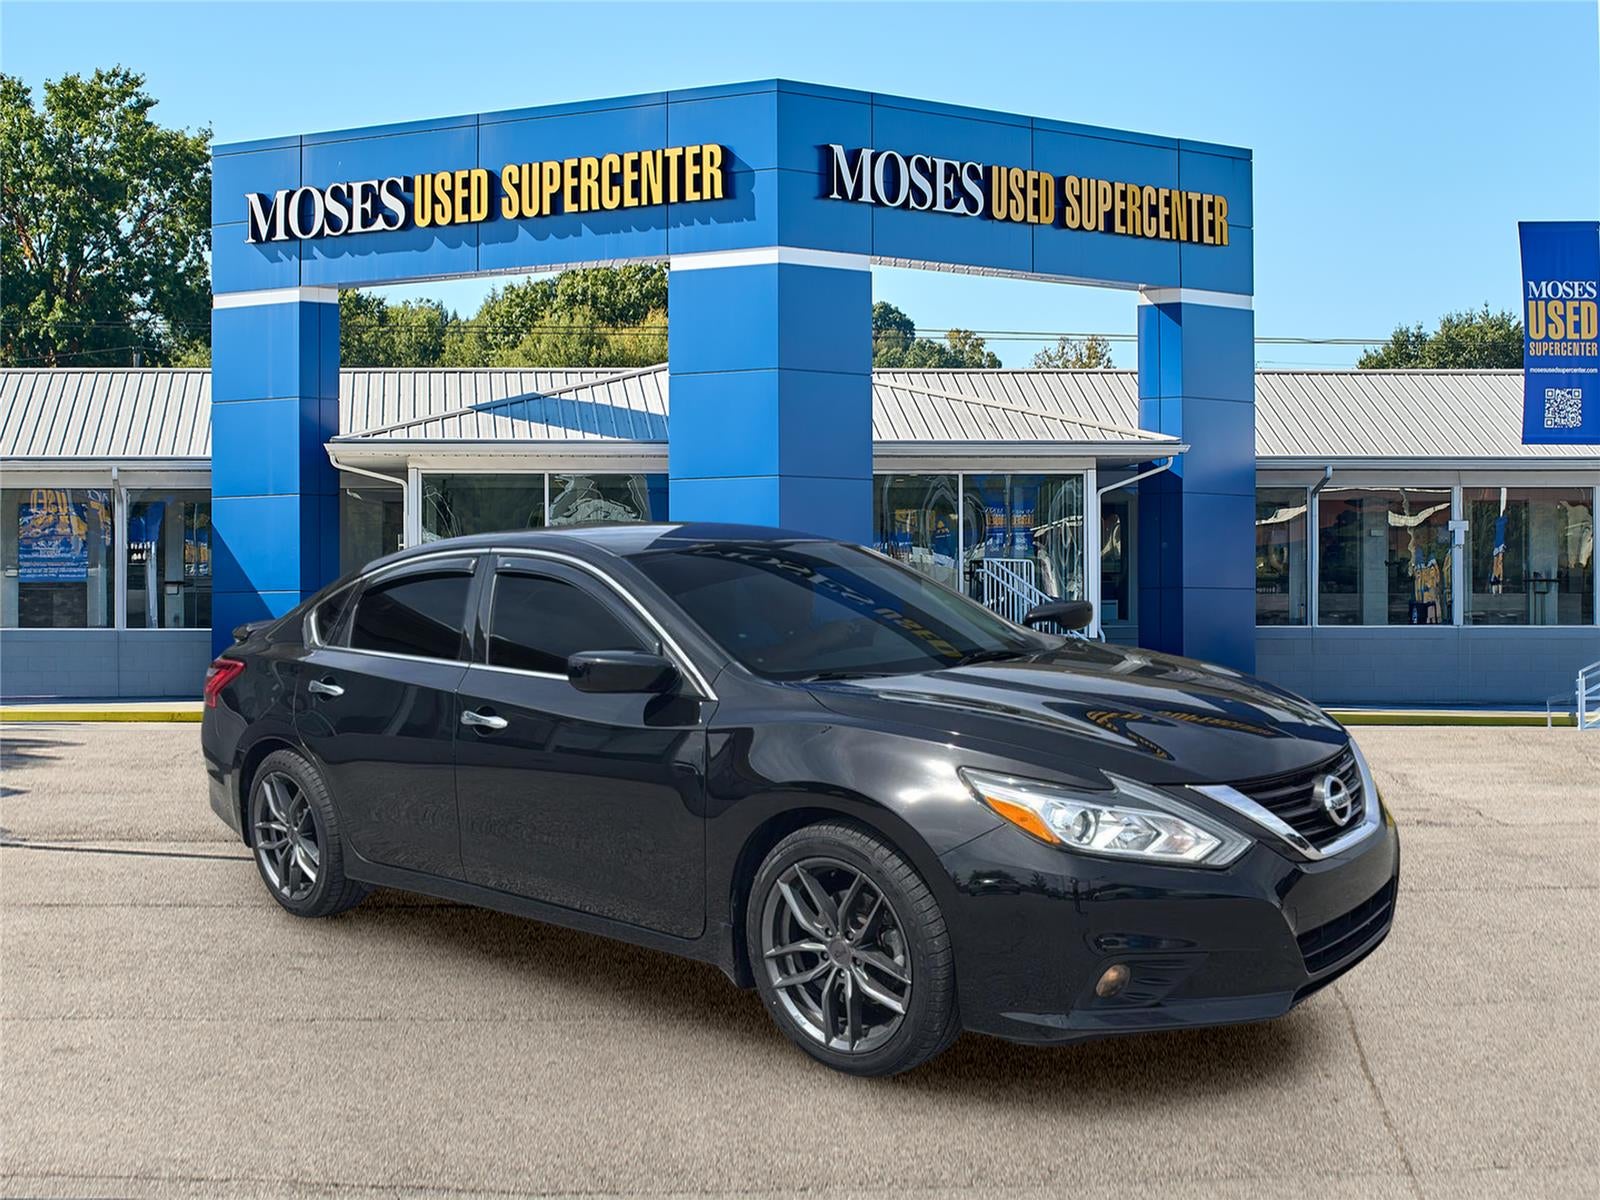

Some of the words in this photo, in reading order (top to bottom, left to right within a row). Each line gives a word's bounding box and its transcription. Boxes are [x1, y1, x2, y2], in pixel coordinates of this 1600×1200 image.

[245, 177, 406, 244] MOSES
[414, 169, 488, 227] USED
[501, 144, 723, 220] SUPERCENTER
[828, 144, 984, 217] MOSES
[991, 165, 1055, 225] USED
[1064, 175, 1229, 246] SUPERCENTER
[1528, 281, 1597, 299] MOSES
[1528, 300, 1598, 340] USED
[1529, 342, 1598, 357] SUPERCENTER
